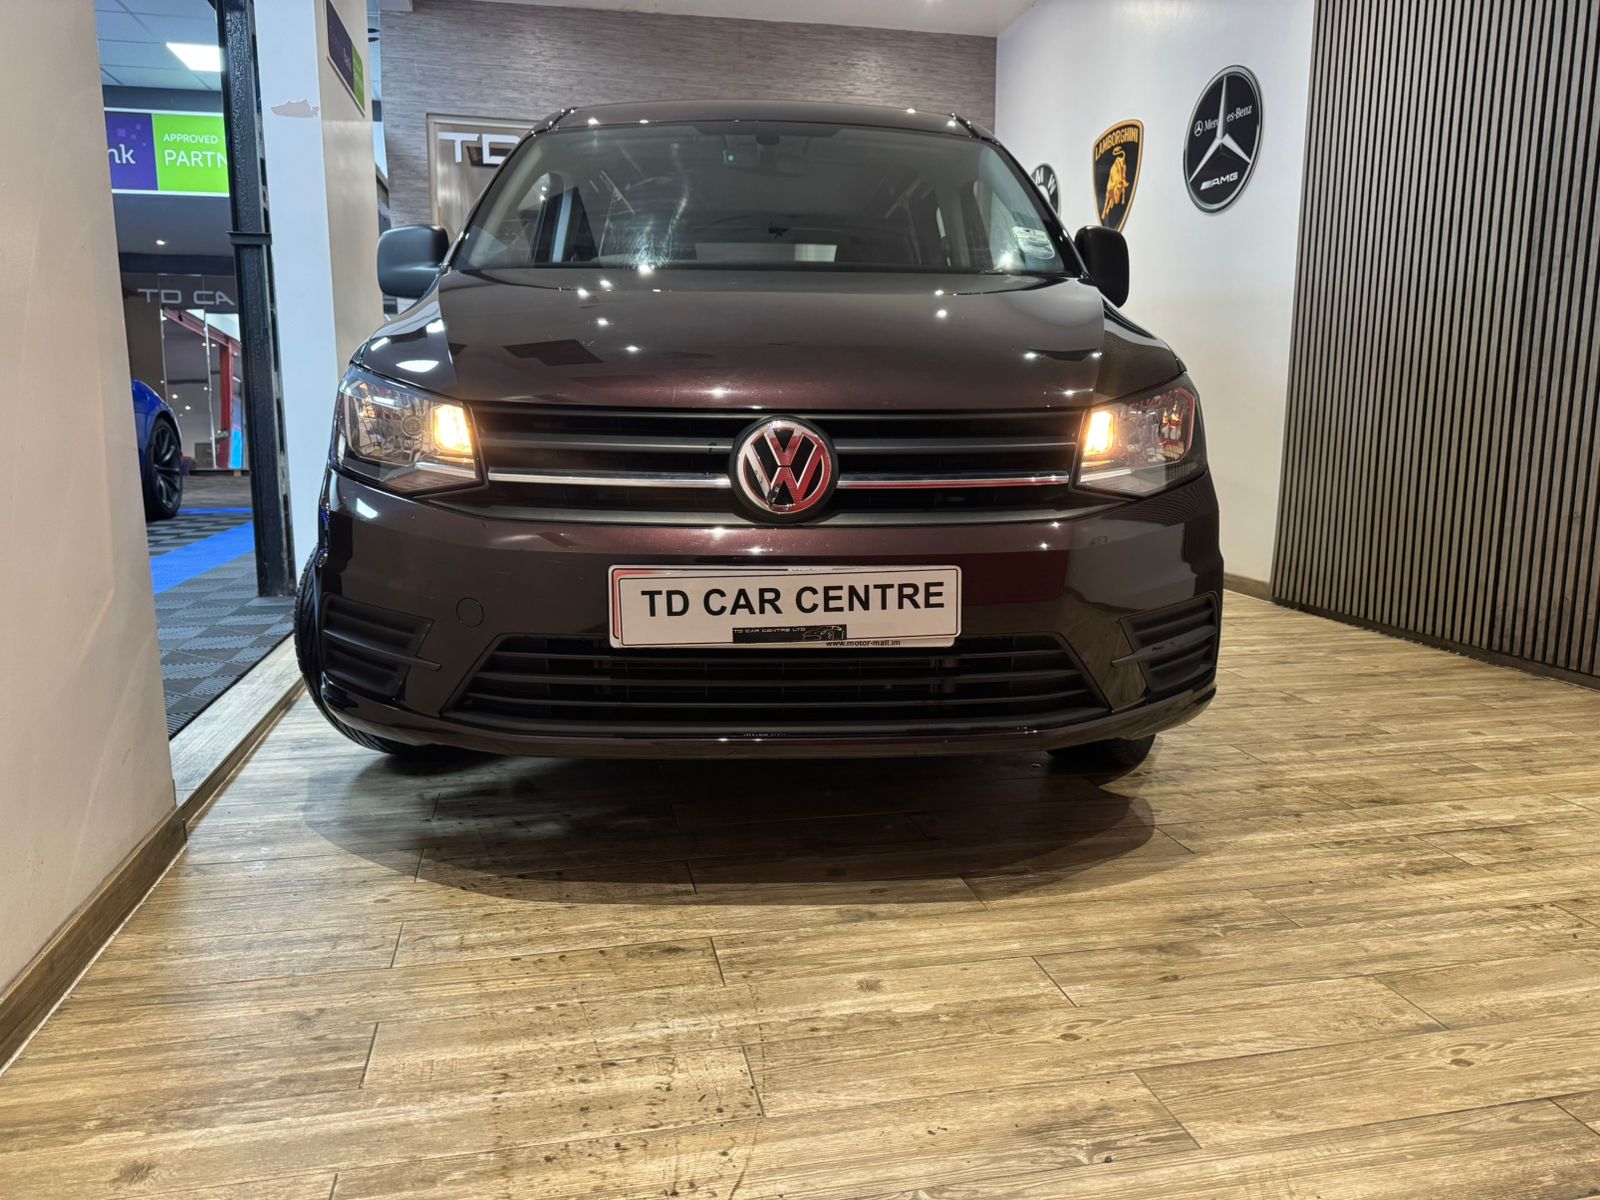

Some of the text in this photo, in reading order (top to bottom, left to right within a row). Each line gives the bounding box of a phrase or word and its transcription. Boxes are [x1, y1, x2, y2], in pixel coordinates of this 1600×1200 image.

[163, 133, 219, 144] APPROVED
[437, 132, 520, 164] TD
[1095, 127, 1138, 161] LAMBORGHINI
[1211, 172, 1238, 187] AMG
[137, 288, 182, 304] TD
[641, 581, 945, 617] TD CAR CENTRE
